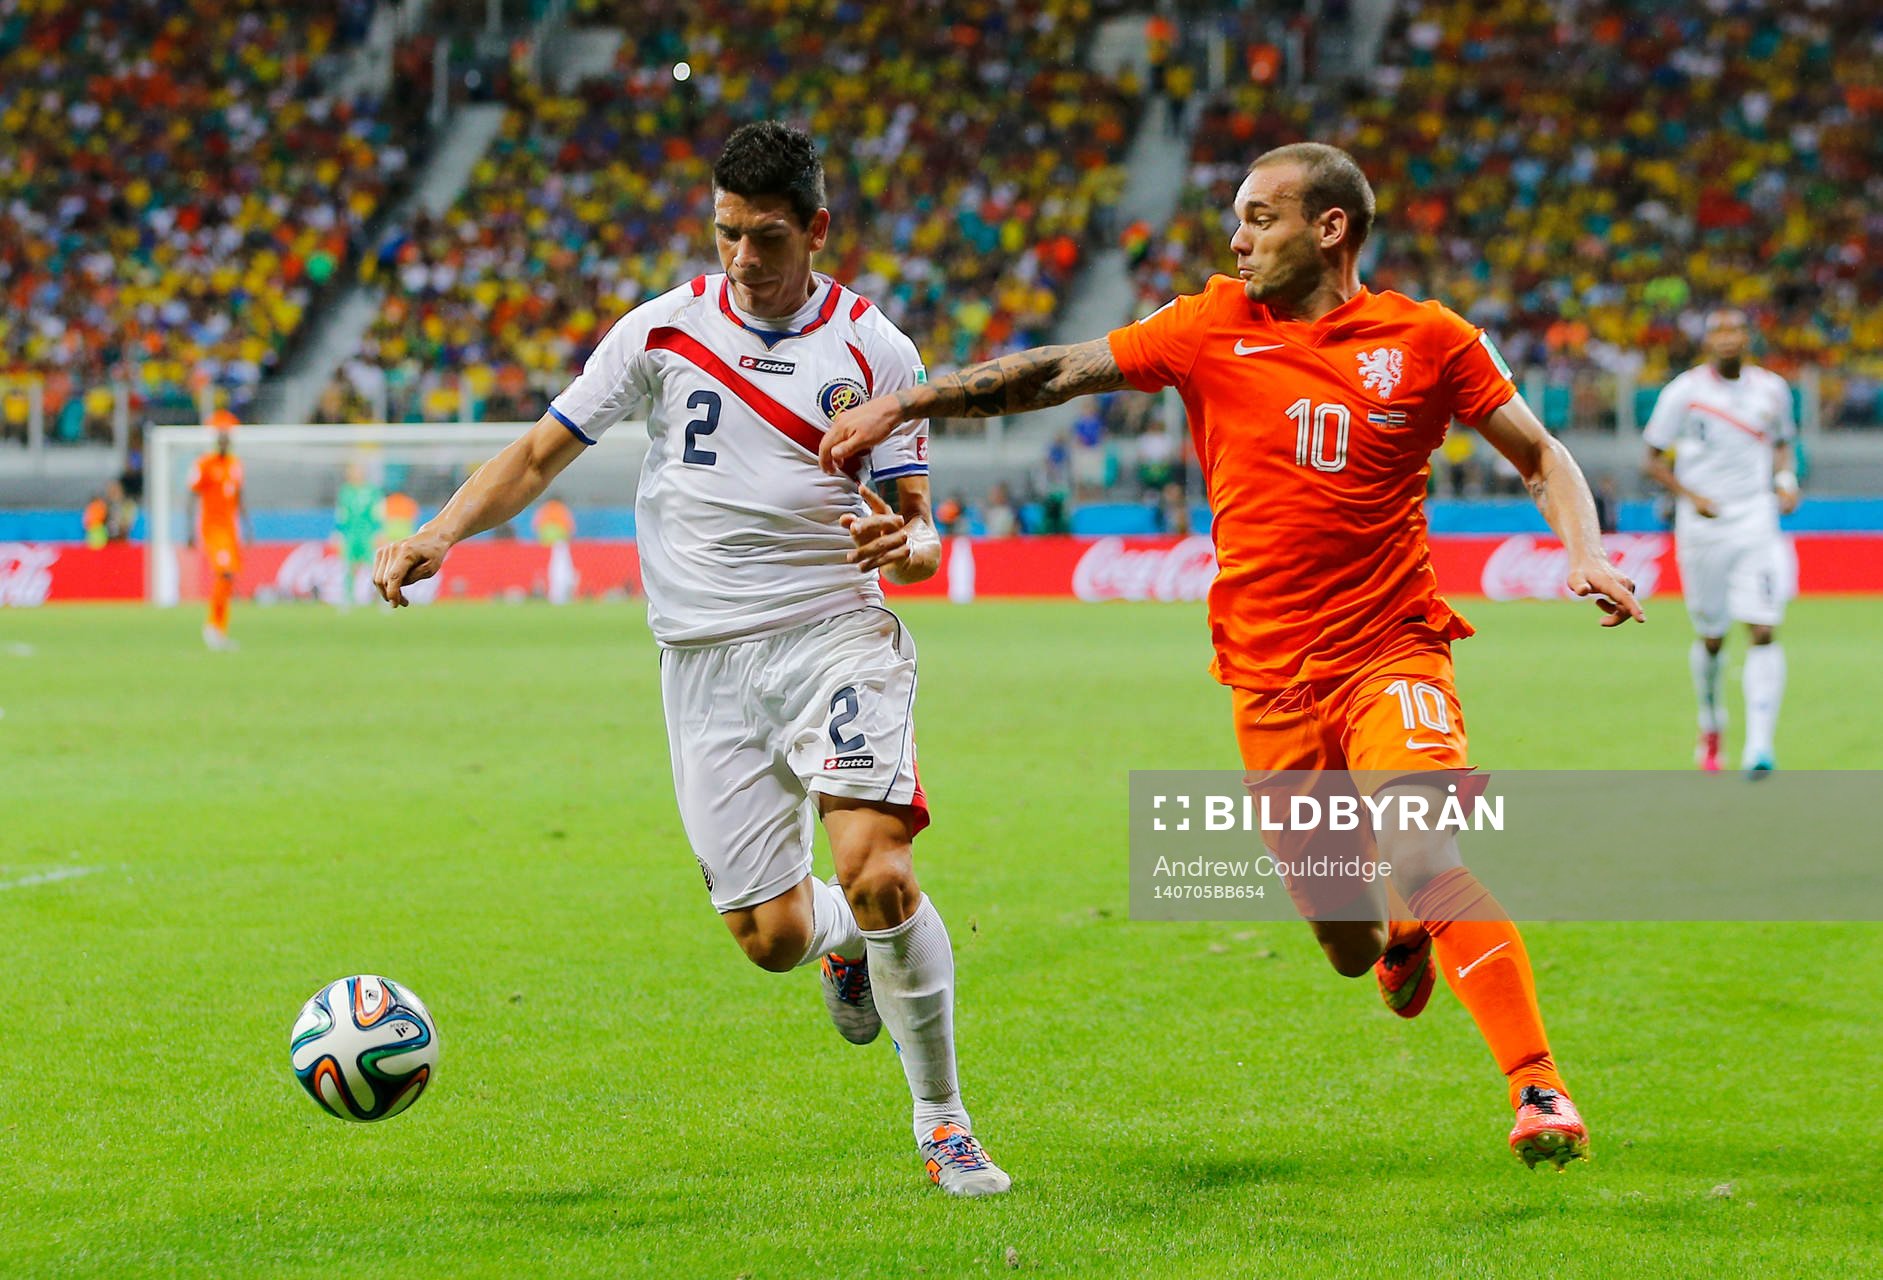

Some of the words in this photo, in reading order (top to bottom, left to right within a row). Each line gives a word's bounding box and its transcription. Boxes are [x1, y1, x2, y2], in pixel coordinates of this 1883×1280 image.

[683, 390, 722, 466] 2
[1284, 398, 1351, 473] 10
[828, 686, 866, 755] 2
[1383, 680, 1453, 735] 10
